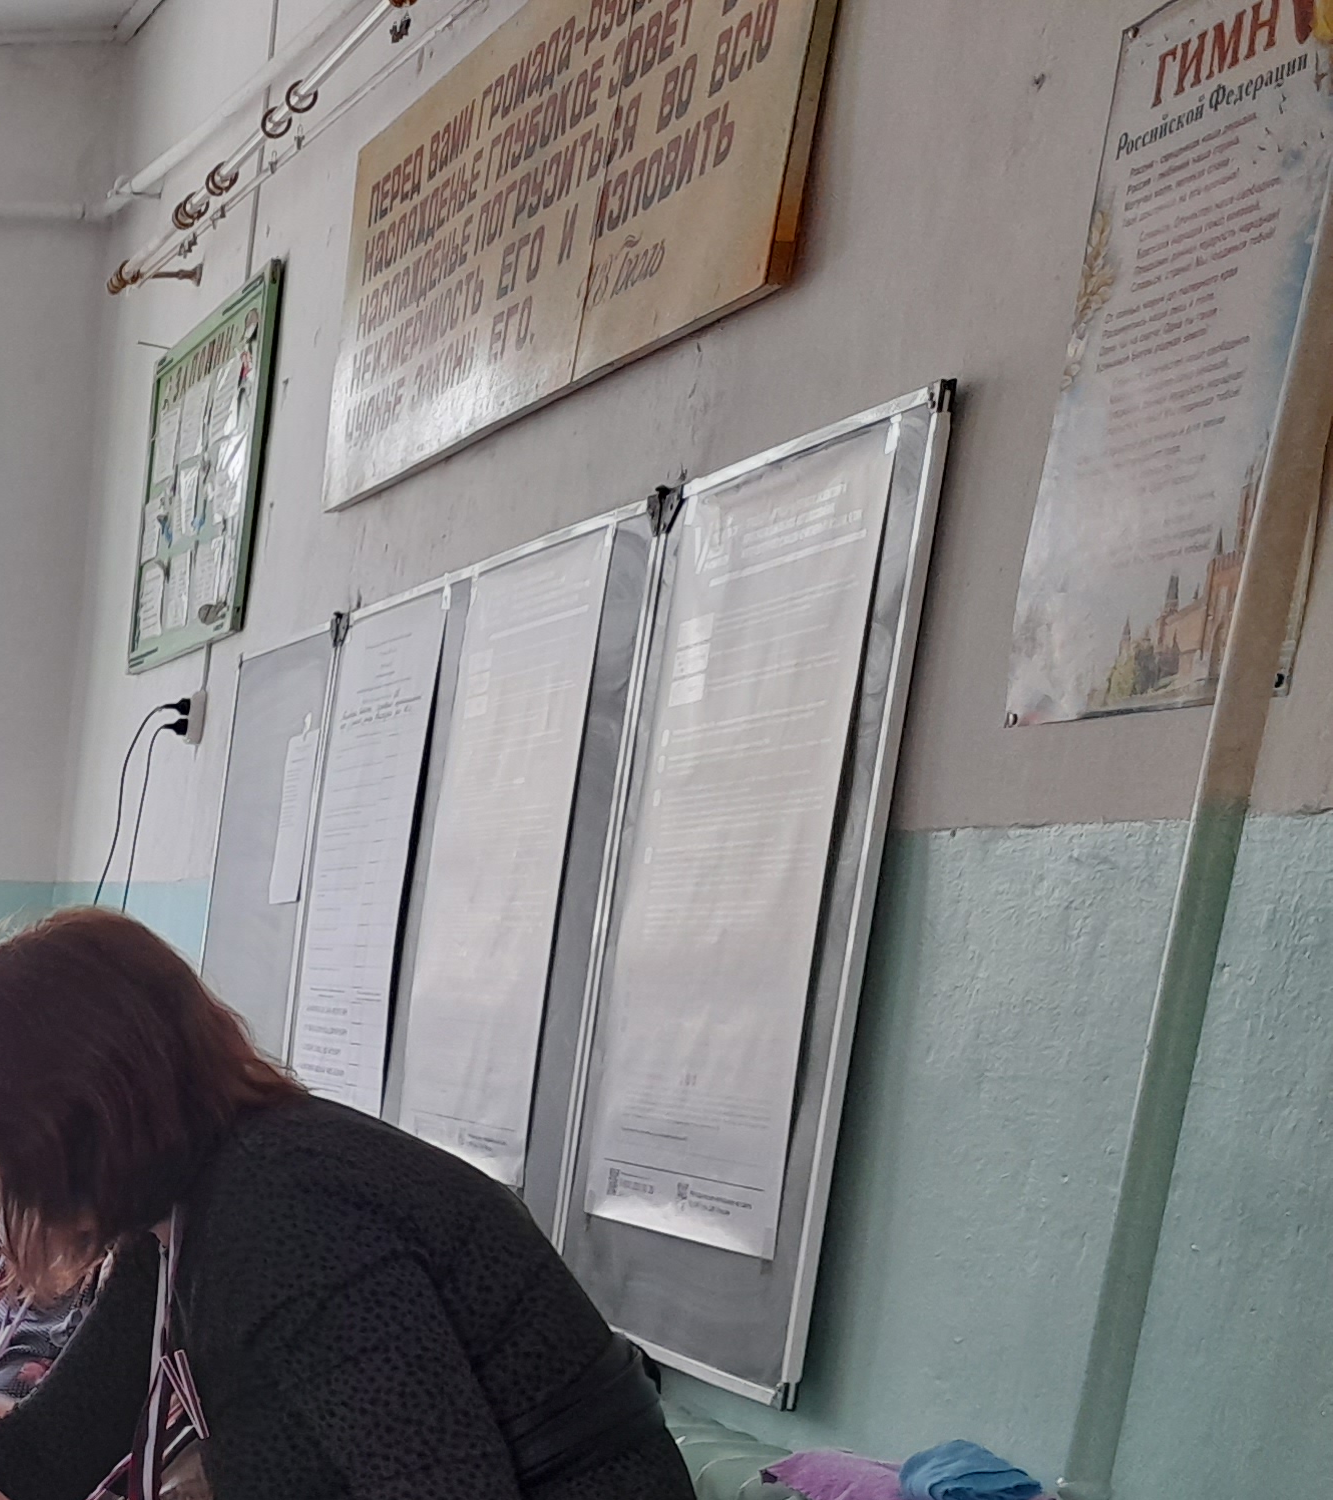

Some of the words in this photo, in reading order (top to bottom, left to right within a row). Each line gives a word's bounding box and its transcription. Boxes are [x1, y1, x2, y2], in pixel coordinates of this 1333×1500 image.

[656, 53, 698, 134] ВО
[707, 0, 779, 98] ВСЮ
[1115, 94, 1205, 161] Российской
[1209, 53, 1309, 112] Федерации
[1150, 0, 1280, 109] ГИМН
[484, 54, 606, 191] ГЛУБОКОЕ
[368, 144, 424, 228] ПЕРЕД
[496, 224, 546, 301] ЕГО
[558, 203, 578, 267] И
